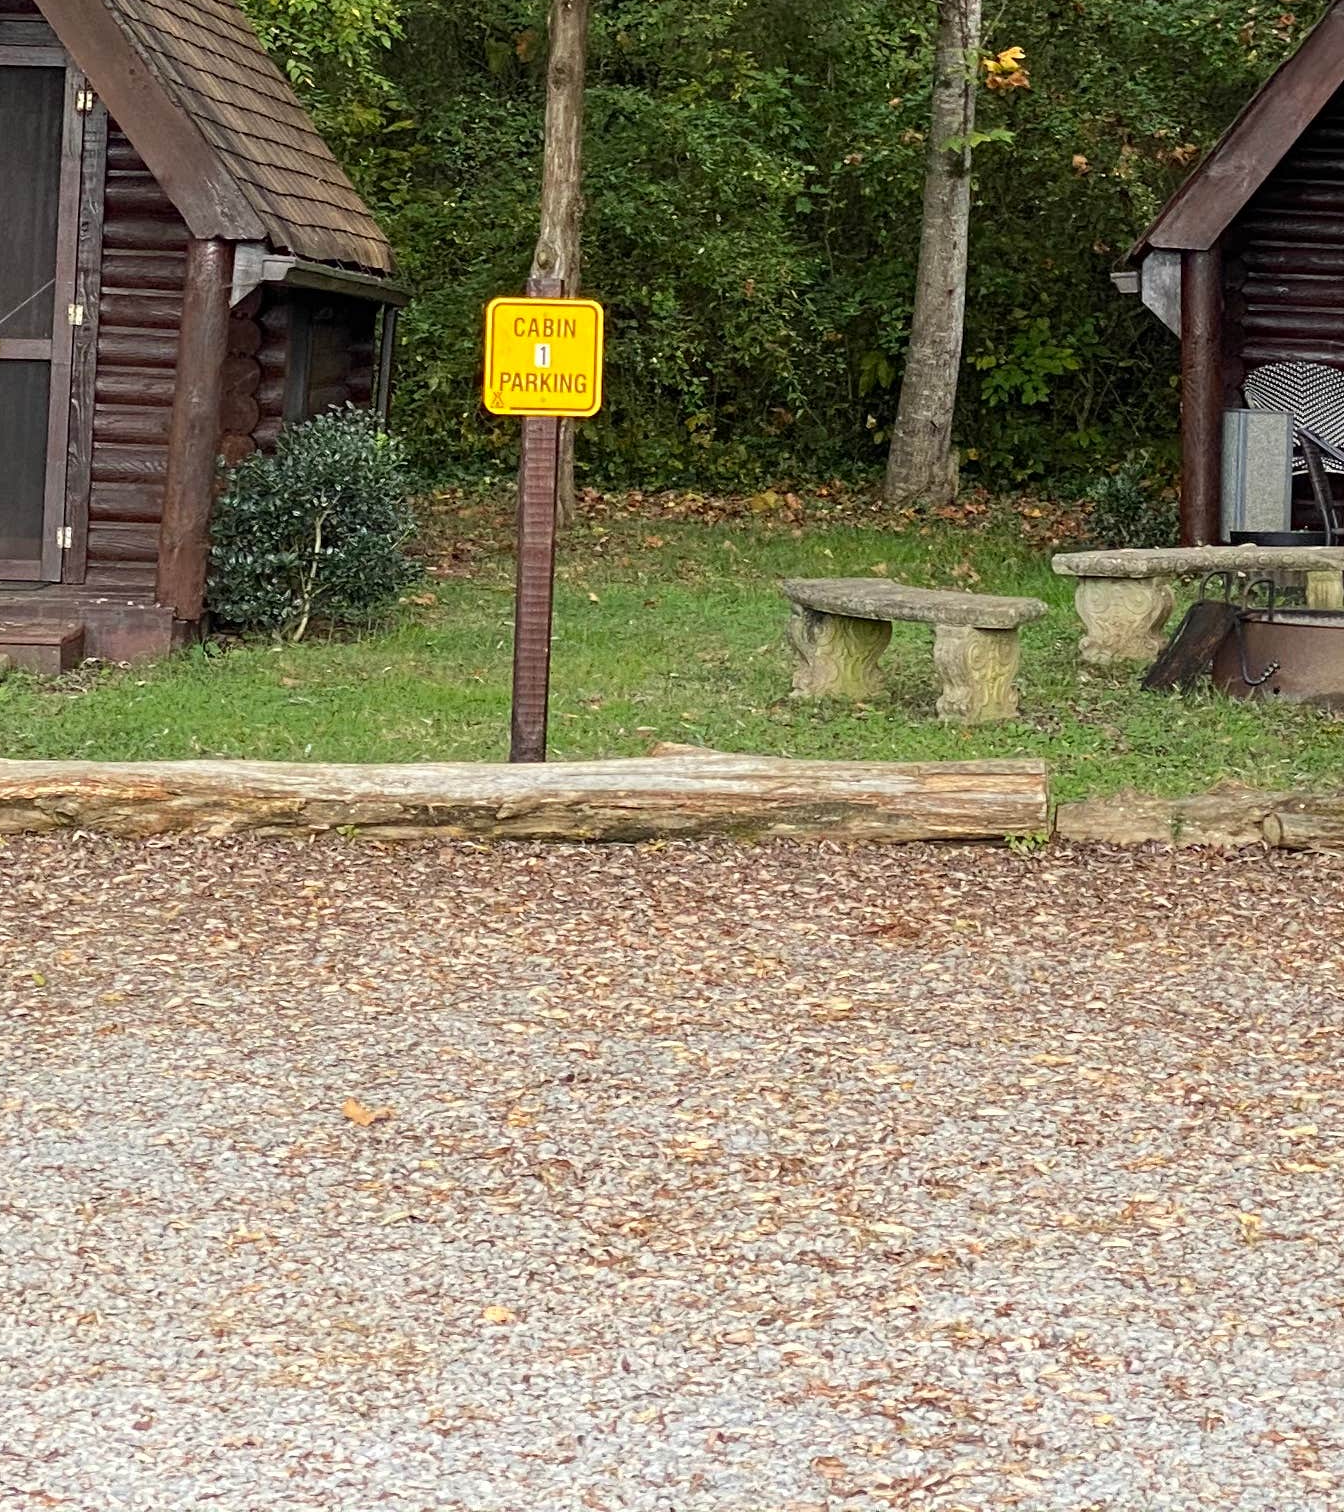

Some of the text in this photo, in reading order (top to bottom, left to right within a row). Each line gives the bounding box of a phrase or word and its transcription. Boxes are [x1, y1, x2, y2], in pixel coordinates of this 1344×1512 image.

[514, 317, 577, 338] CABIN
[539, 346, 547, 365] 1
[499, 372, 587, 393] PARKING
